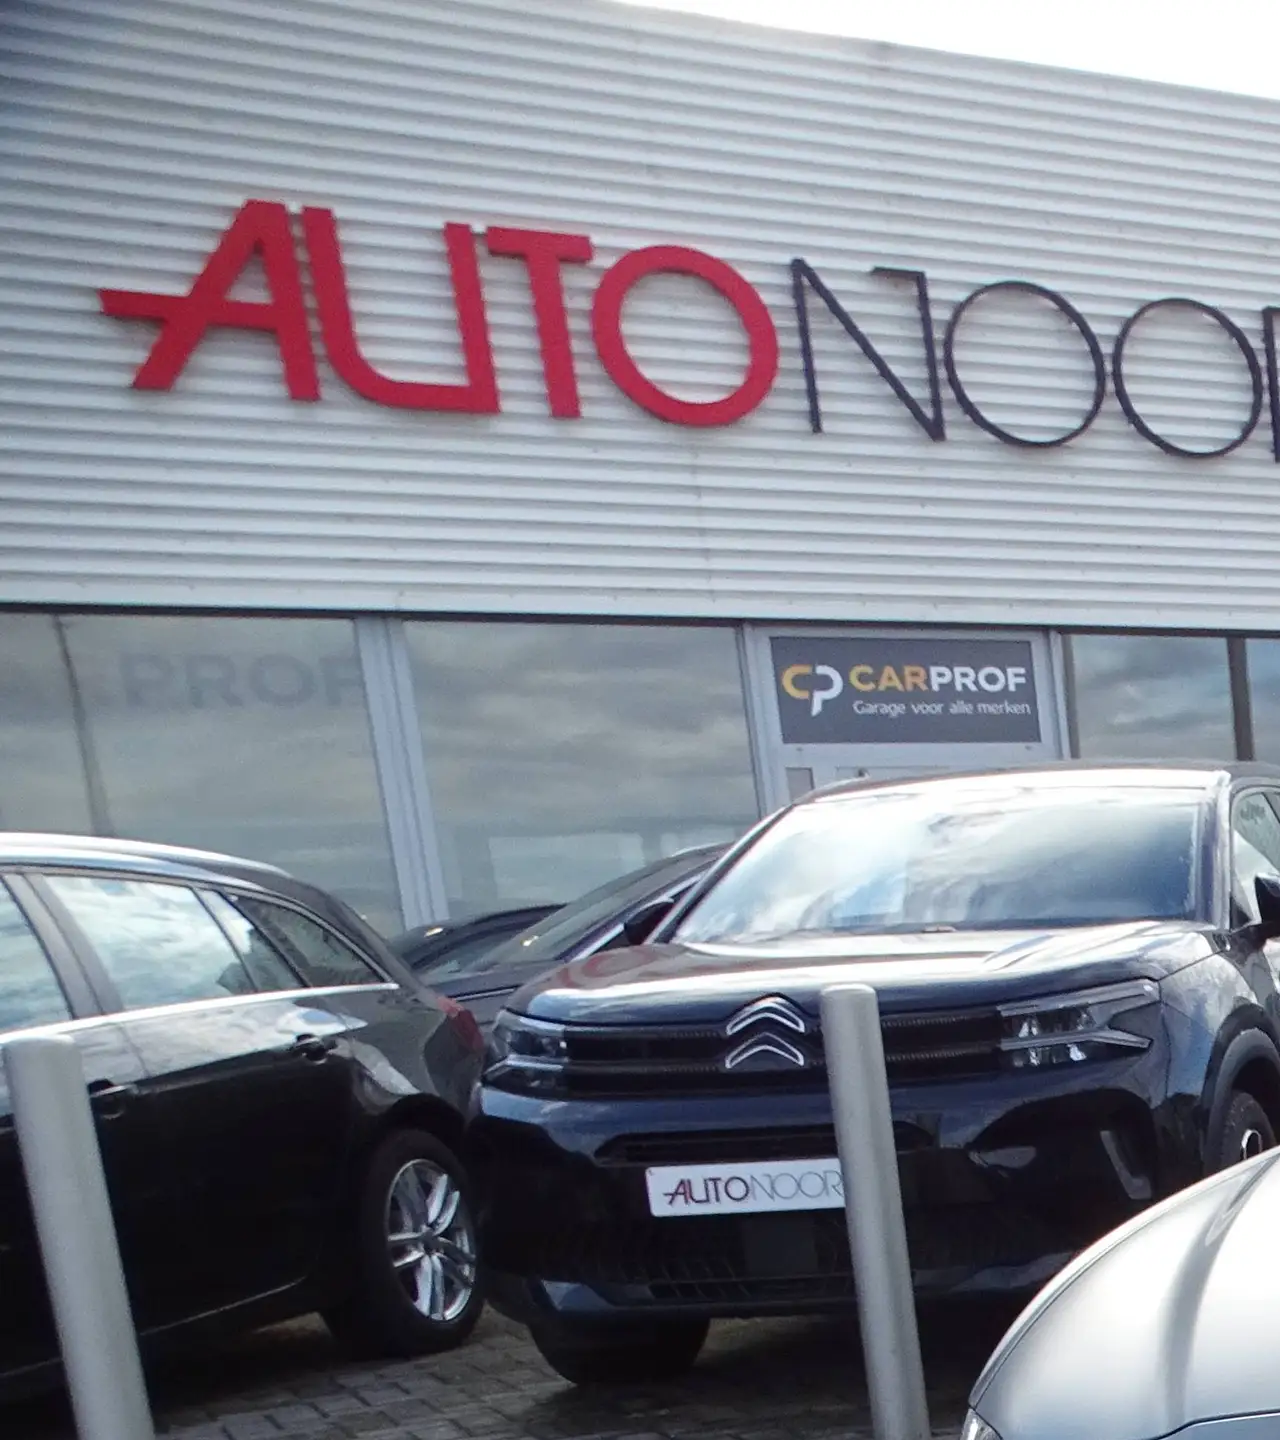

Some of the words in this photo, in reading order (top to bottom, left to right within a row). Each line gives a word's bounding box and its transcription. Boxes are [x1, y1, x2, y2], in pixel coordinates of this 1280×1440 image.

[849, 664, 1027, 693] CARPROF
[852, 700, 905, 718] Garage
[911, 702, 944, 715] voor
[949, 701, 974, 715] alle
[977, 702, 1031, 715] merken
[663, 1170, 845, 1206] AUTONOOR
